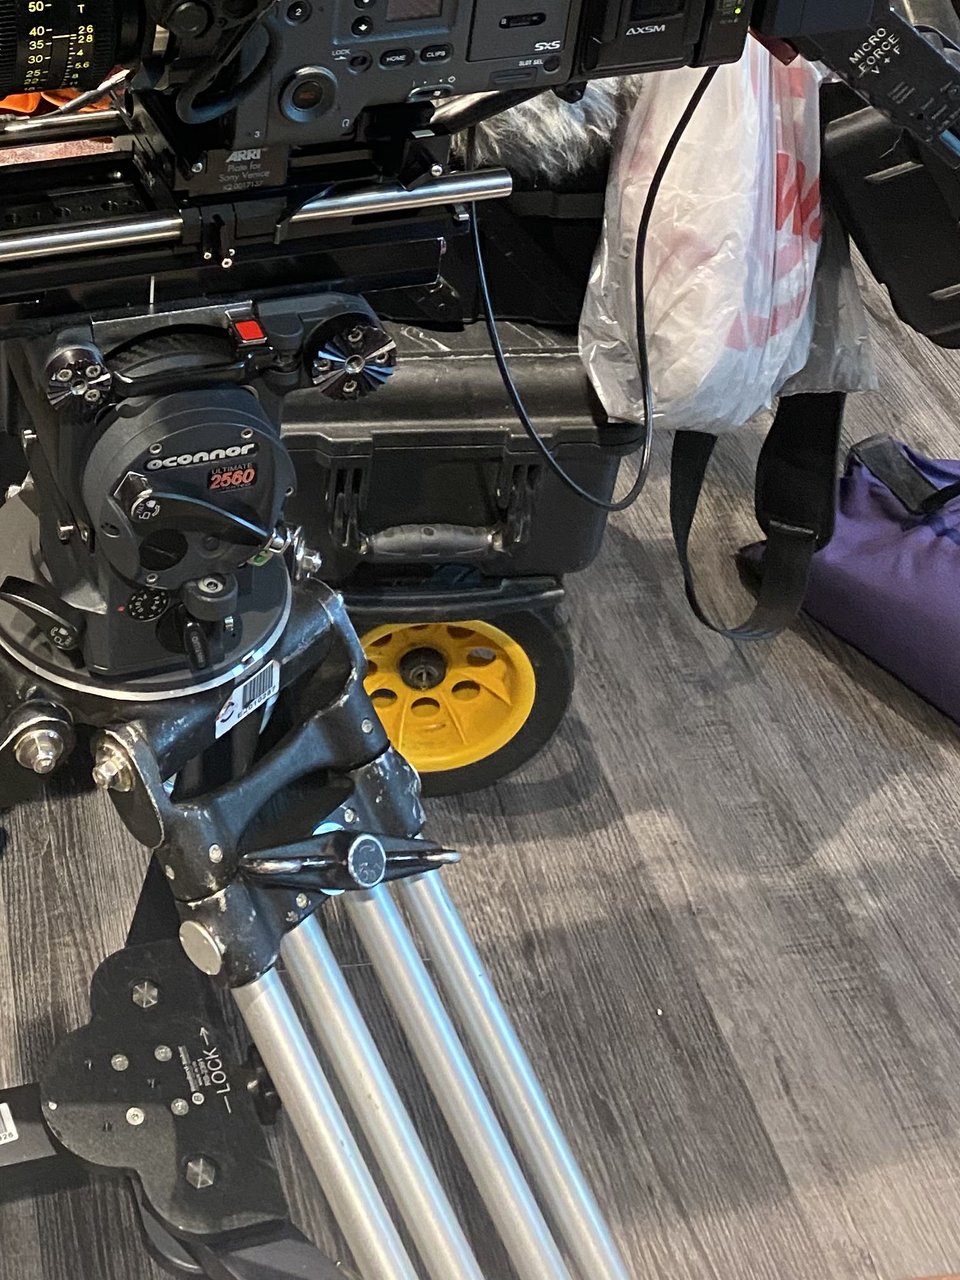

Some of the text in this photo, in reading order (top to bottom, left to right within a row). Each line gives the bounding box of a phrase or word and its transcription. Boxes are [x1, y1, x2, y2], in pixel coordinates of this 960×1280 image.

[28, 1, 44, 12] 50
[295, 8, 302, 16] 2
[29, 25, 45, 36] 40
[625, 24, 666, 36] AXSM
[28, 40, 44, 50] 35
[848, 27, 886, 64] MICRO
[331, 48, 351, 57] LOCK
[386, 54, 406, 62] HOME
[426, 50, 446, 58] CLIPS
[858, 33, 900, 74] FORCE
[27, 54, 43, 64] 30
[518, 59, 532, 67] SLOT
[25, 69, 41, 78] 25
[254, 130, 260, 138] 3
[225, 148, 261, 163] ARRI
[146, 443, 255, 470] oconnor
[211, 462, 253, 475] ULTIMATE
[209, 468, 256, 490] 2560
[202, 1047, 231, 1094] LOCK
